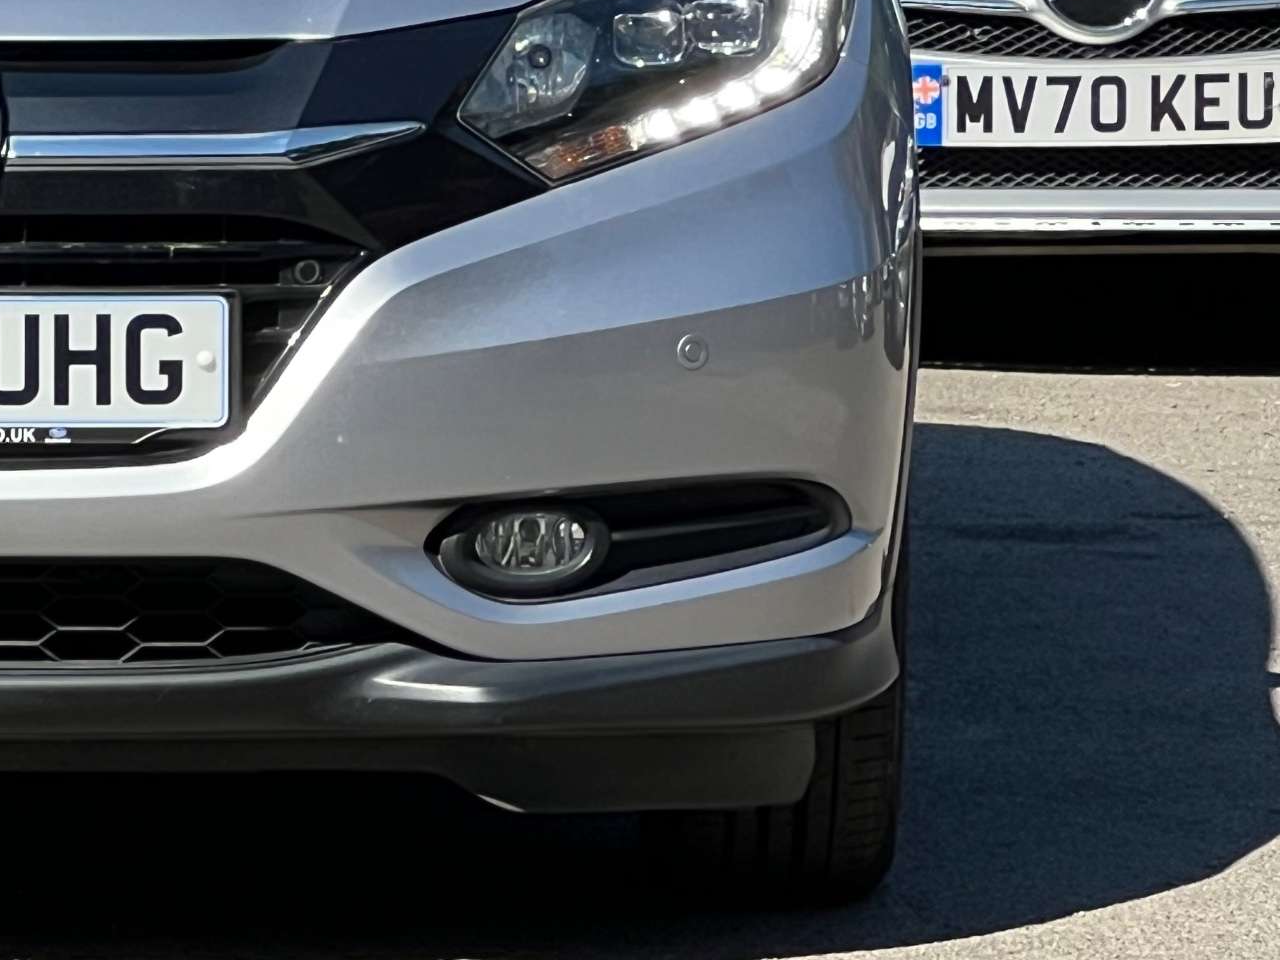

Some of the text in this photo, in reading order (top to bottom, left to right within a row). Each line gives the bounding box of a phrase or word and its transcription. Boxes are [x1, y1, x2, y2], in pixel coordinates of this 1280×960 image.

[914, 112, 937, 129] GB
[956, 72, 1274, 134] MV70 KEU
